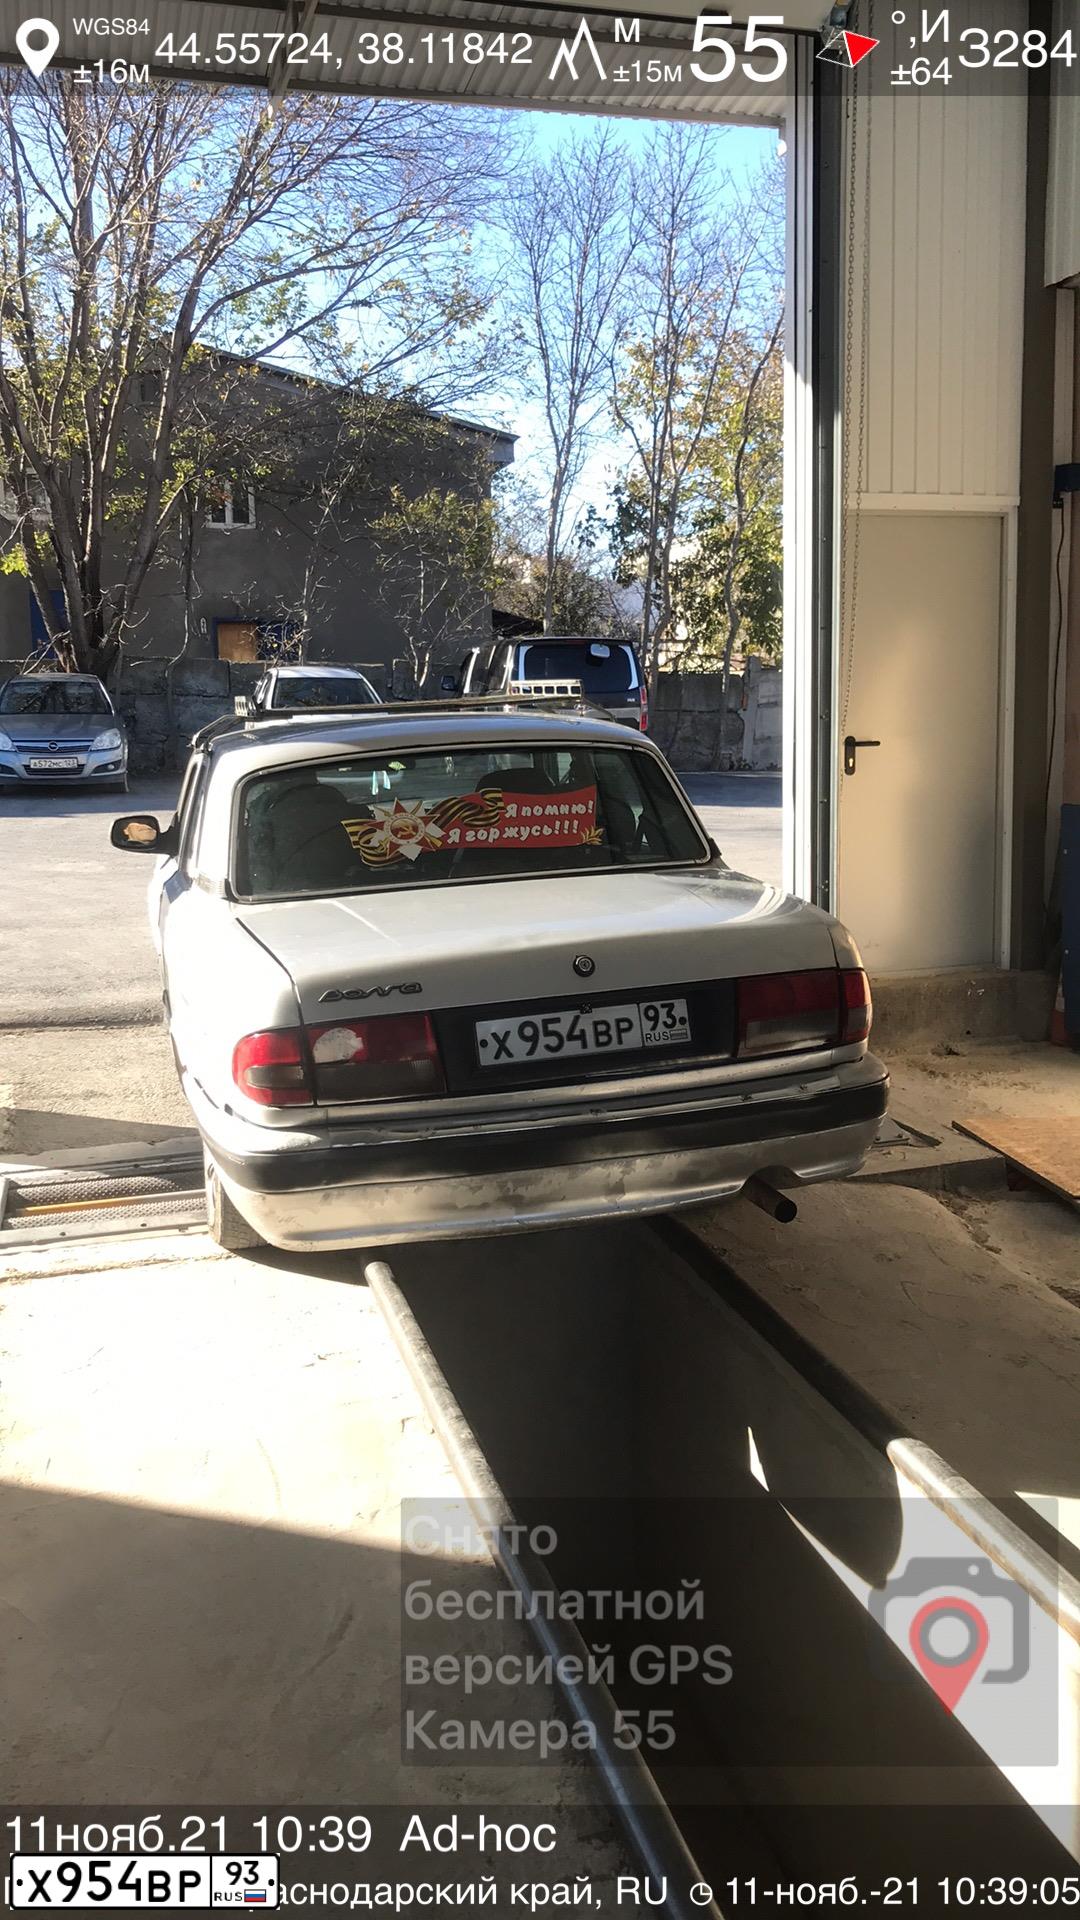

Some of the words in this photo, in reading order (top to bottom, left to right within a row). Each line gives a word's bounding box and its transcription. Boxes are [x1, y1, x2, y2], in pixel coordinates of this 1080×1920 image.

[505, 803, 517, 819] Я
[521, 800, 594, 817] помню!
[447, 827, 461, 844] Я
[490, 1014, 634, 1060] Х954ВР
[643, 1003, 677, 1031] 93
[644, 1030, 670, 1042] RUS
